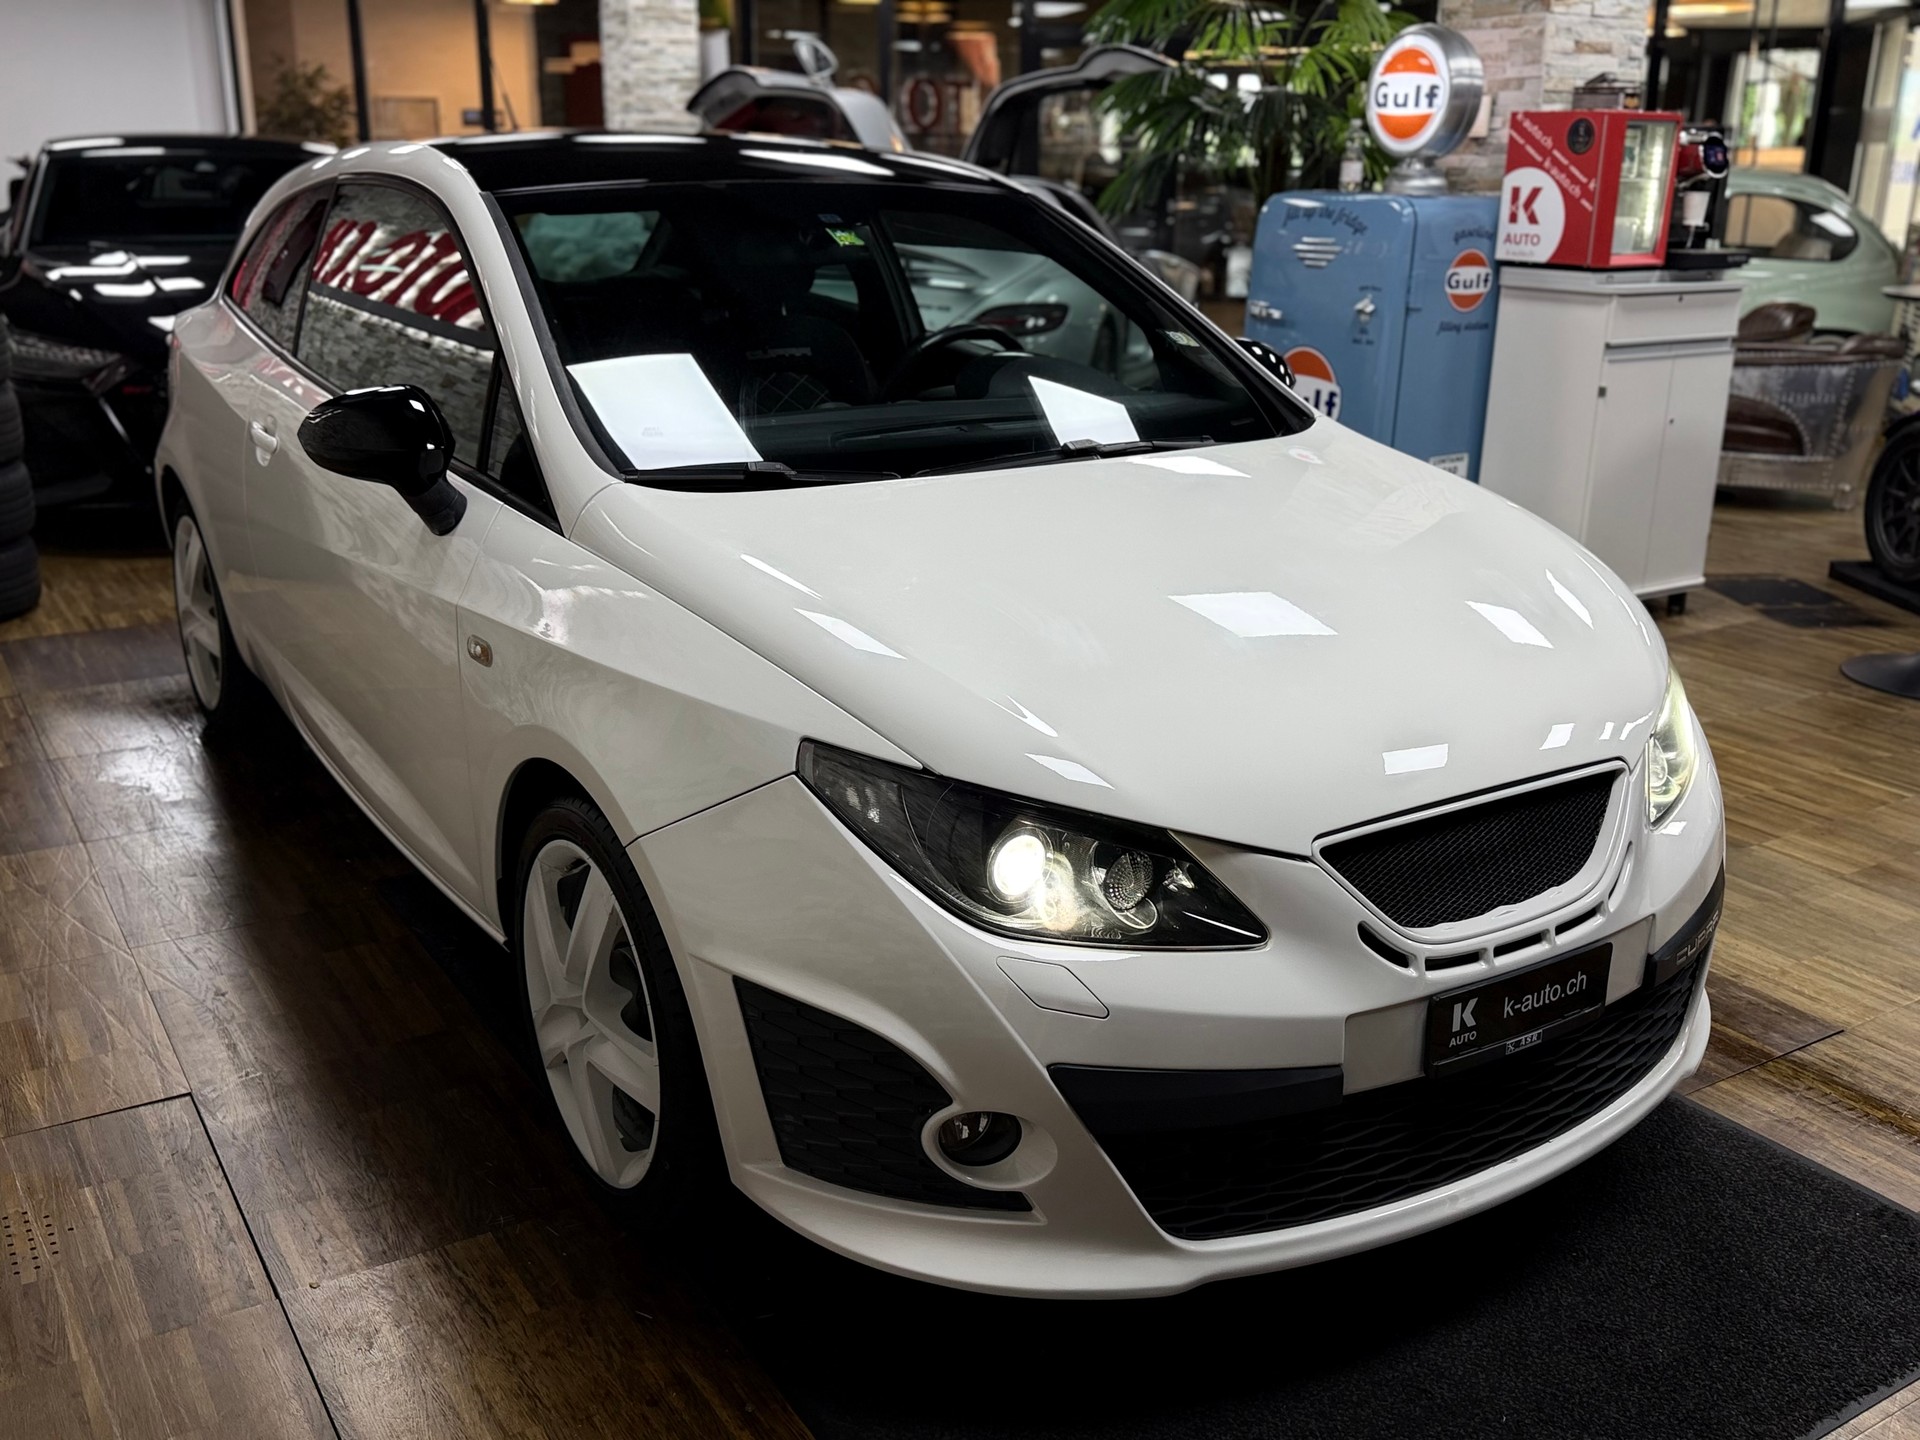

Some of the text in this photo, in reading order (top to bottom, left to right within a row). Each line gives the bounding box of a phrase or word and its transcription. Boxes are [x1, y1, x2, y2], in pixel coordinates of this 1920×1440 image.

[1374, 81, 1440, 109] Gulf
[1508, 185, 1543, 225] K
[1503, 233, 1541, 246] AUTO
[1446, 271, 1492, 290] Gulf
[1503, 970, 1587, 1019] k-auto.ch
[1451, 997, 1479, 1033] K
[1449, 1031, 1477, 1048] AUTO
